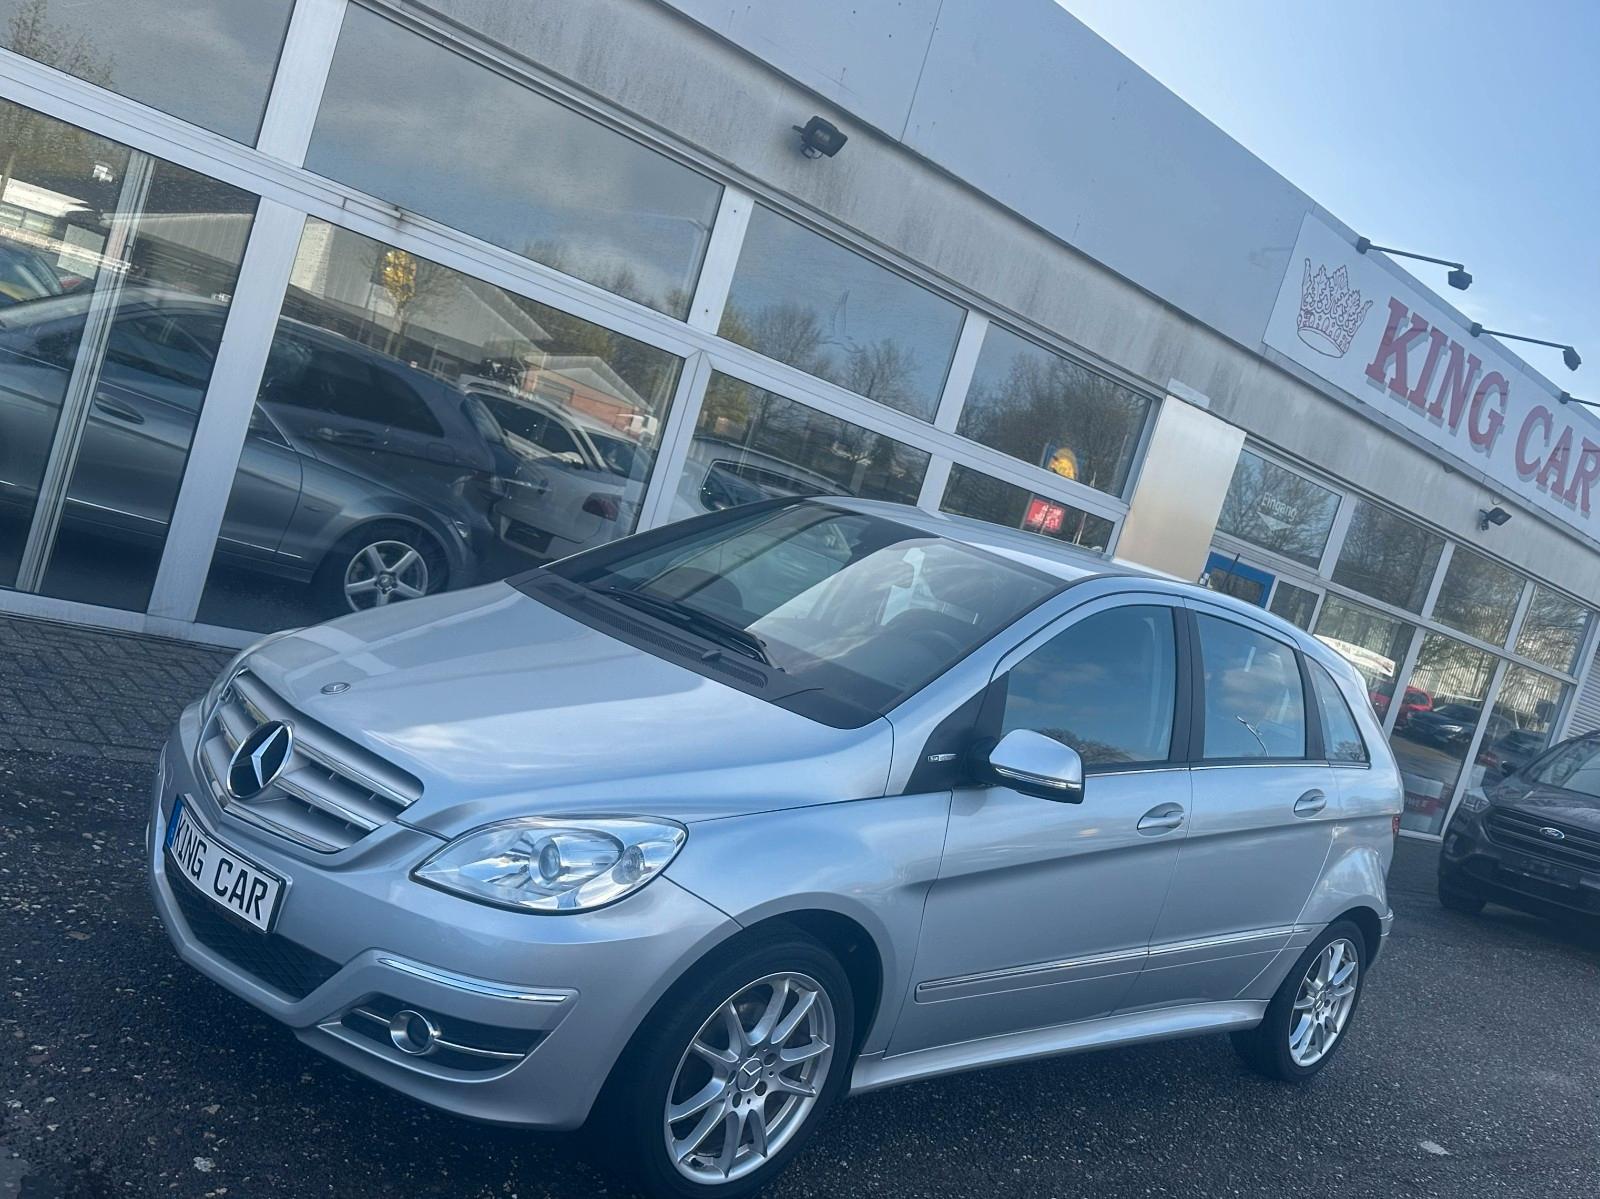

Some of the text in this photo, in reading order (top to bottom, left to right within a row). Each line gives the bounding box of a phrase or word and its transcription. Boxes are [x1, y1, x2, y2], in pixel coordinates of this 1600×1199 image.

[1365, 296, 1600, 517] KING CAR
[1261, 491, 1298, 522] Eingang
[173, 811, 269, 921] KING CAR
